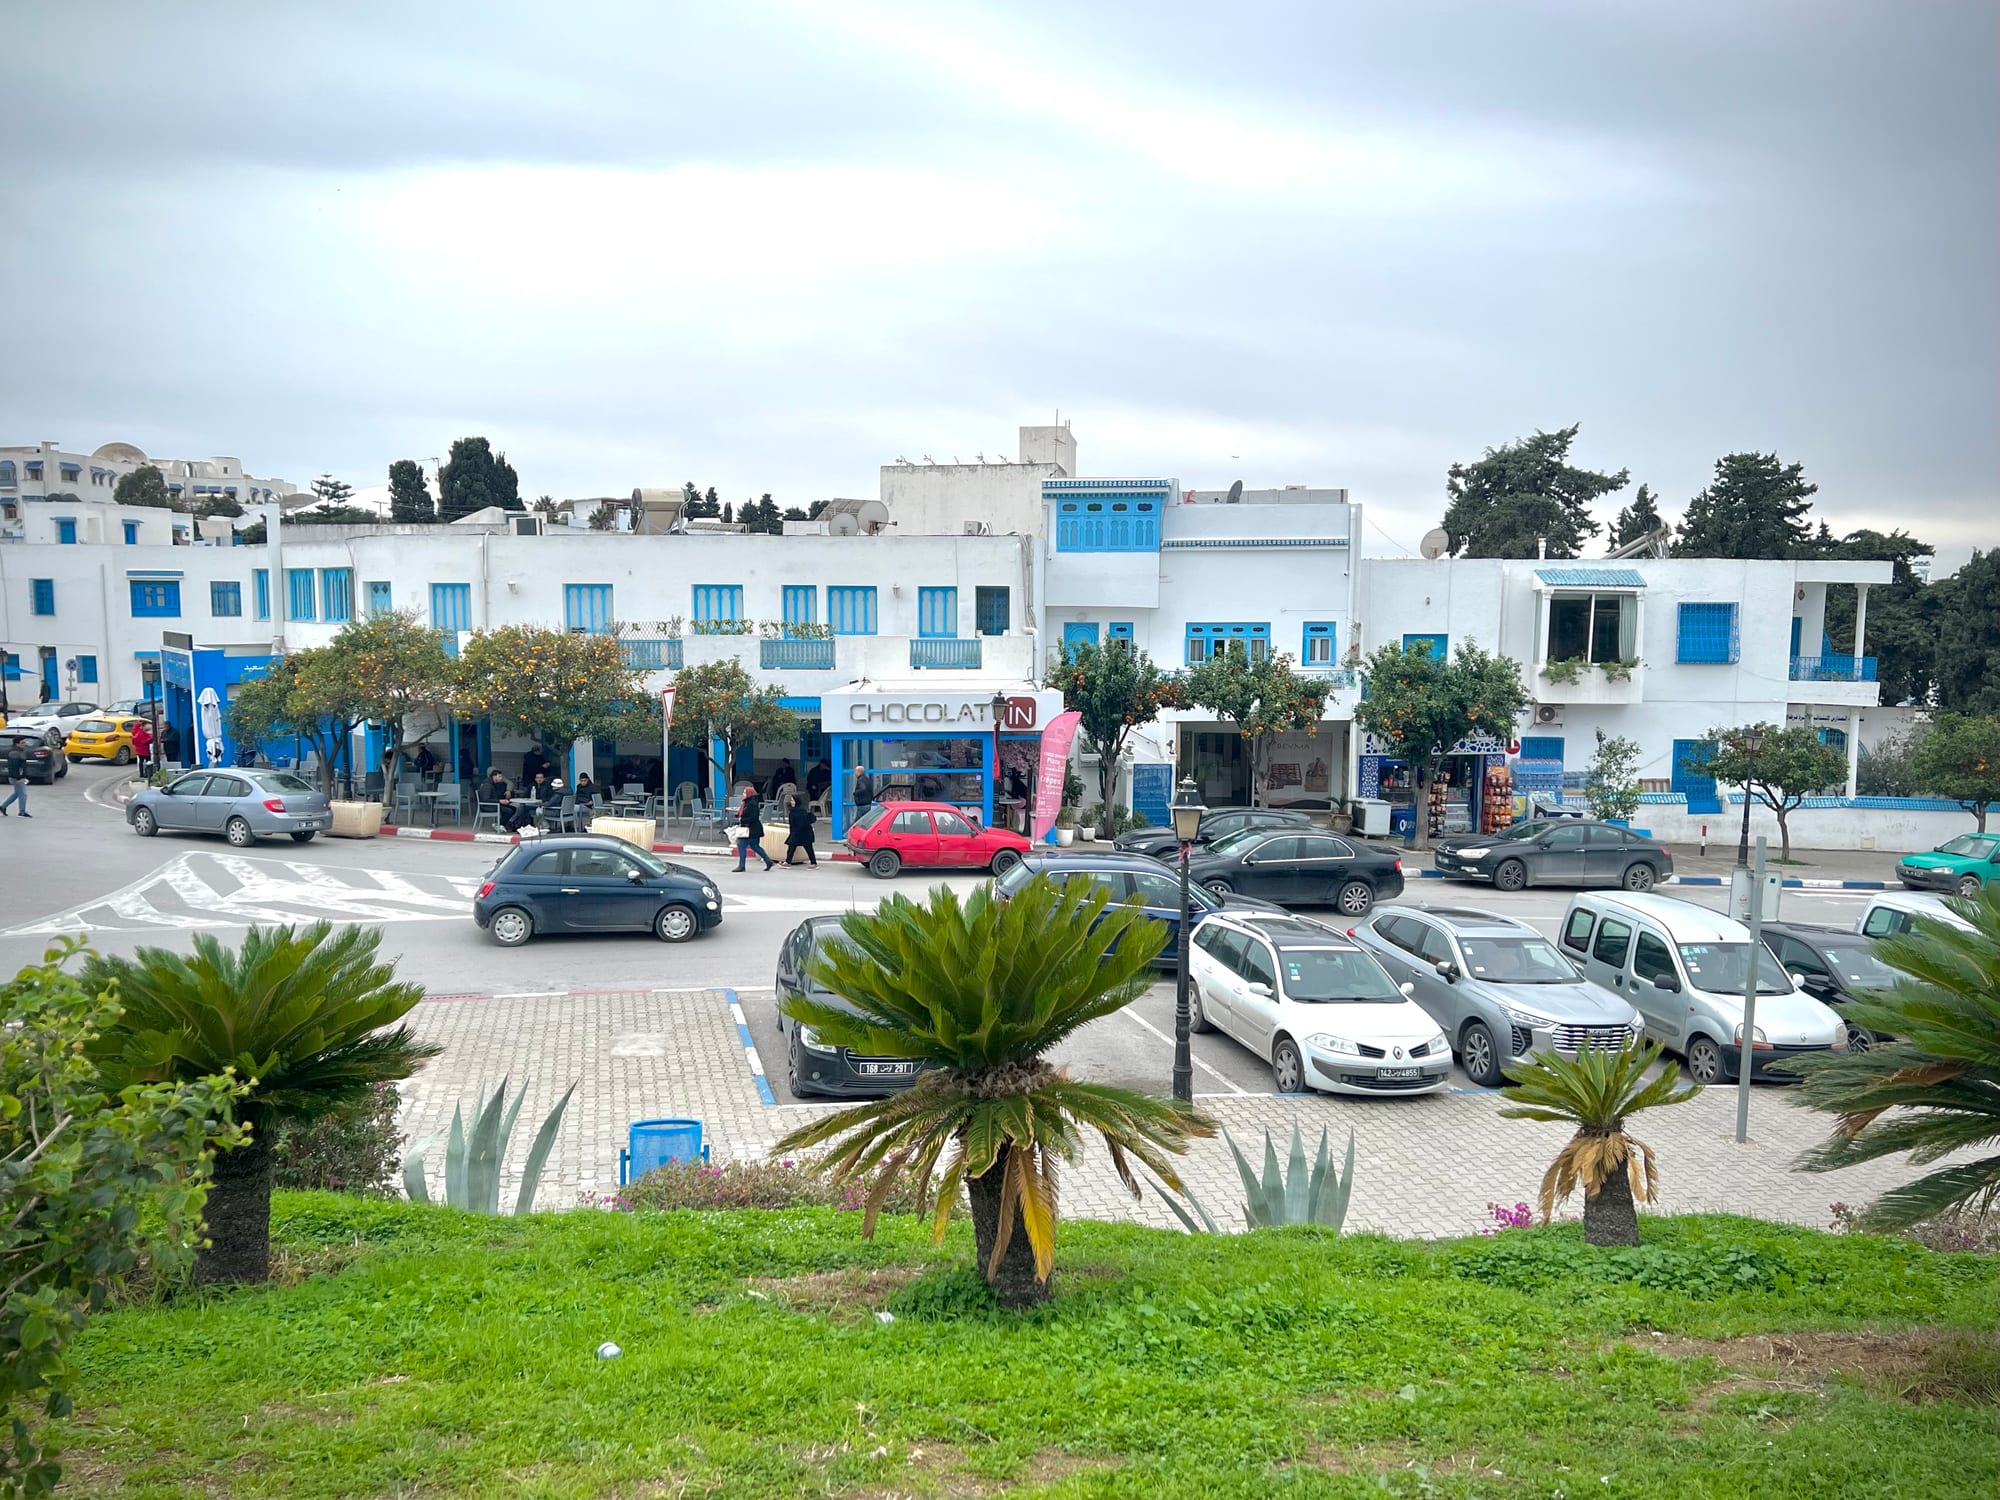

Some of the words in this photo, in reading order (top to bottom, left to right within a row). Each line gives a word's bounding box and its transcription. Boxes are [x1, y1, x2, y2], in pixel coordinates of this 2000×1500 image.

[850, 703, 990, 723] CHOCOLAT
[1008, 700, 1033, 725] iN
[866, 1064, 878, 1073] 168
[895, 1064, 907, 1073] 291
